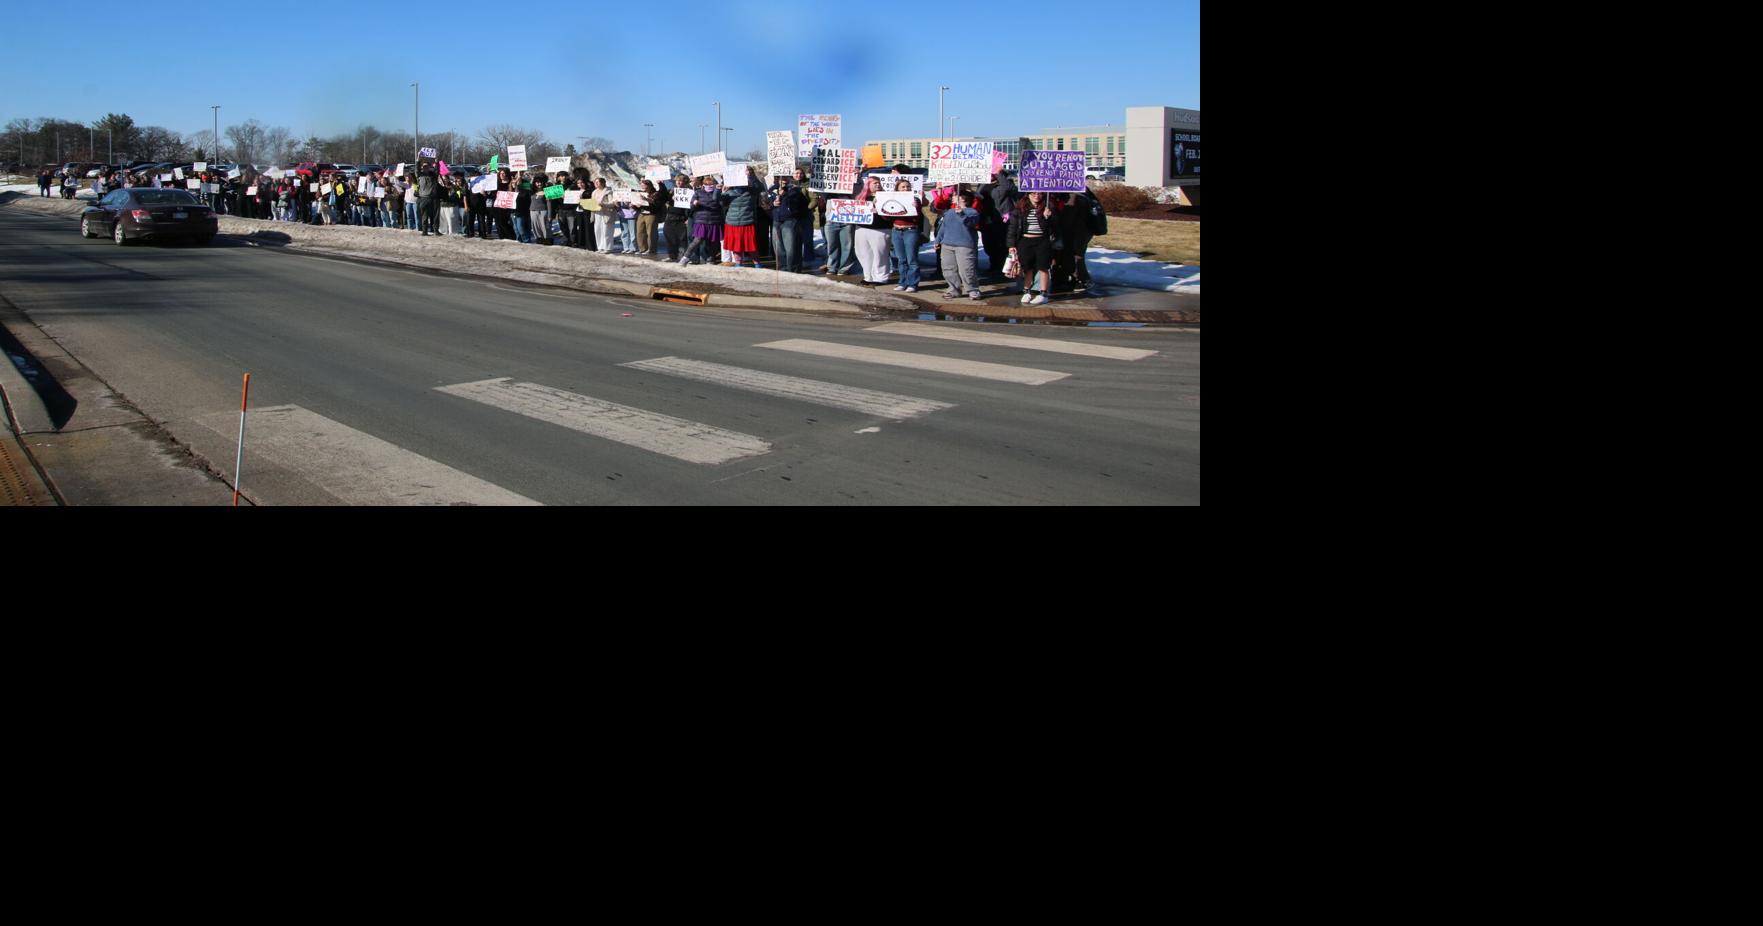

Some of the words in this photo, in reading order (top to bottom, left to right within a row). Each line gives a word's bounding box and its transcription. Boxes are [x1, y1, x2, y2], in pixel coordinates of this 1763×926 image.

[931, 145, 952, 160] 32
[953, 143, 992, 155] HUMAN
[1022, 160, 1084, 171] OUTRAGED
[1021, 178, 1083, 189] ATTENTION
[831, 213, 872, 223] MELTING
